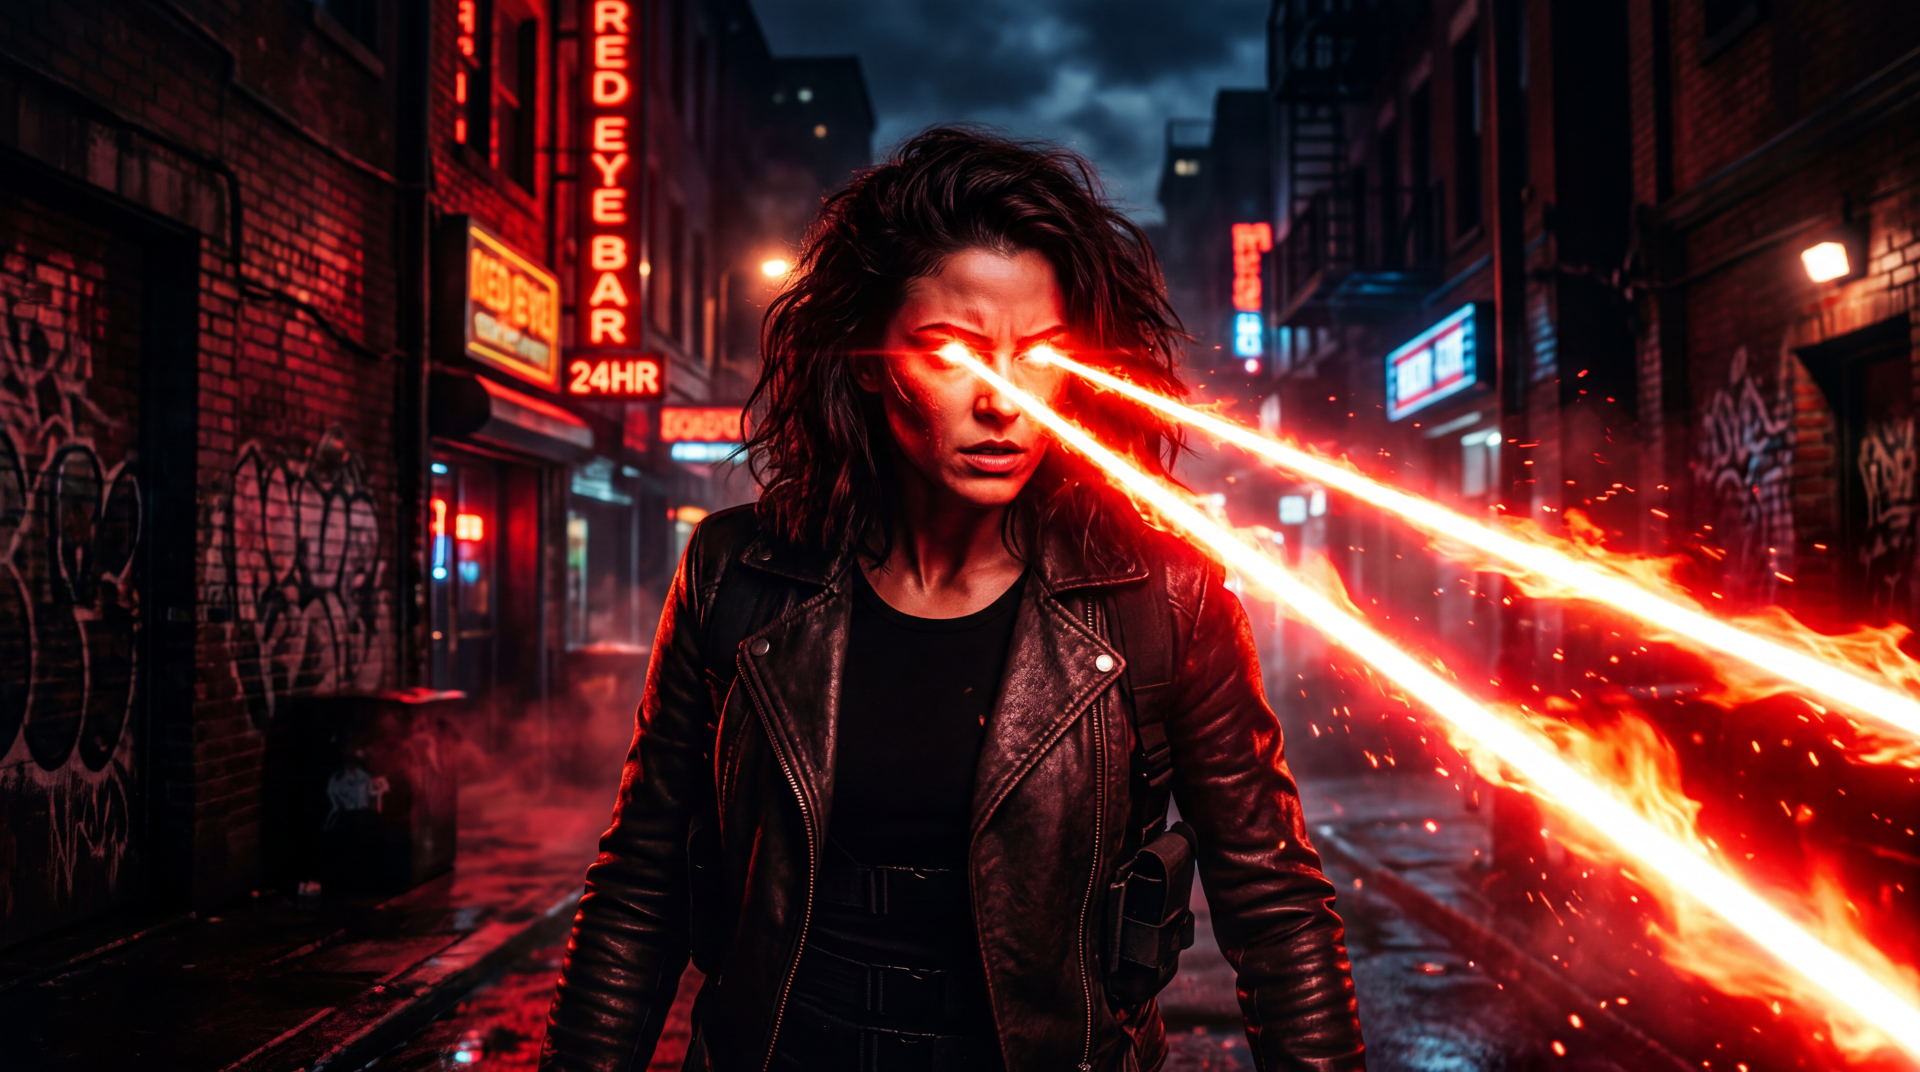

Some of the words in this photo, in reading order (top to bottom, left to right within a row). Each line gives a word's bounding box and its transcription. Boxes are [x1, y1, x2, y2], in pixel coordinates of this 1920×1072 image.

[593, 0, 630, 107] RED
[590, 116, 629, 223] EYE
[589, 235, 629, 344] BAR
[569, 360, 660, 395] 24HR
